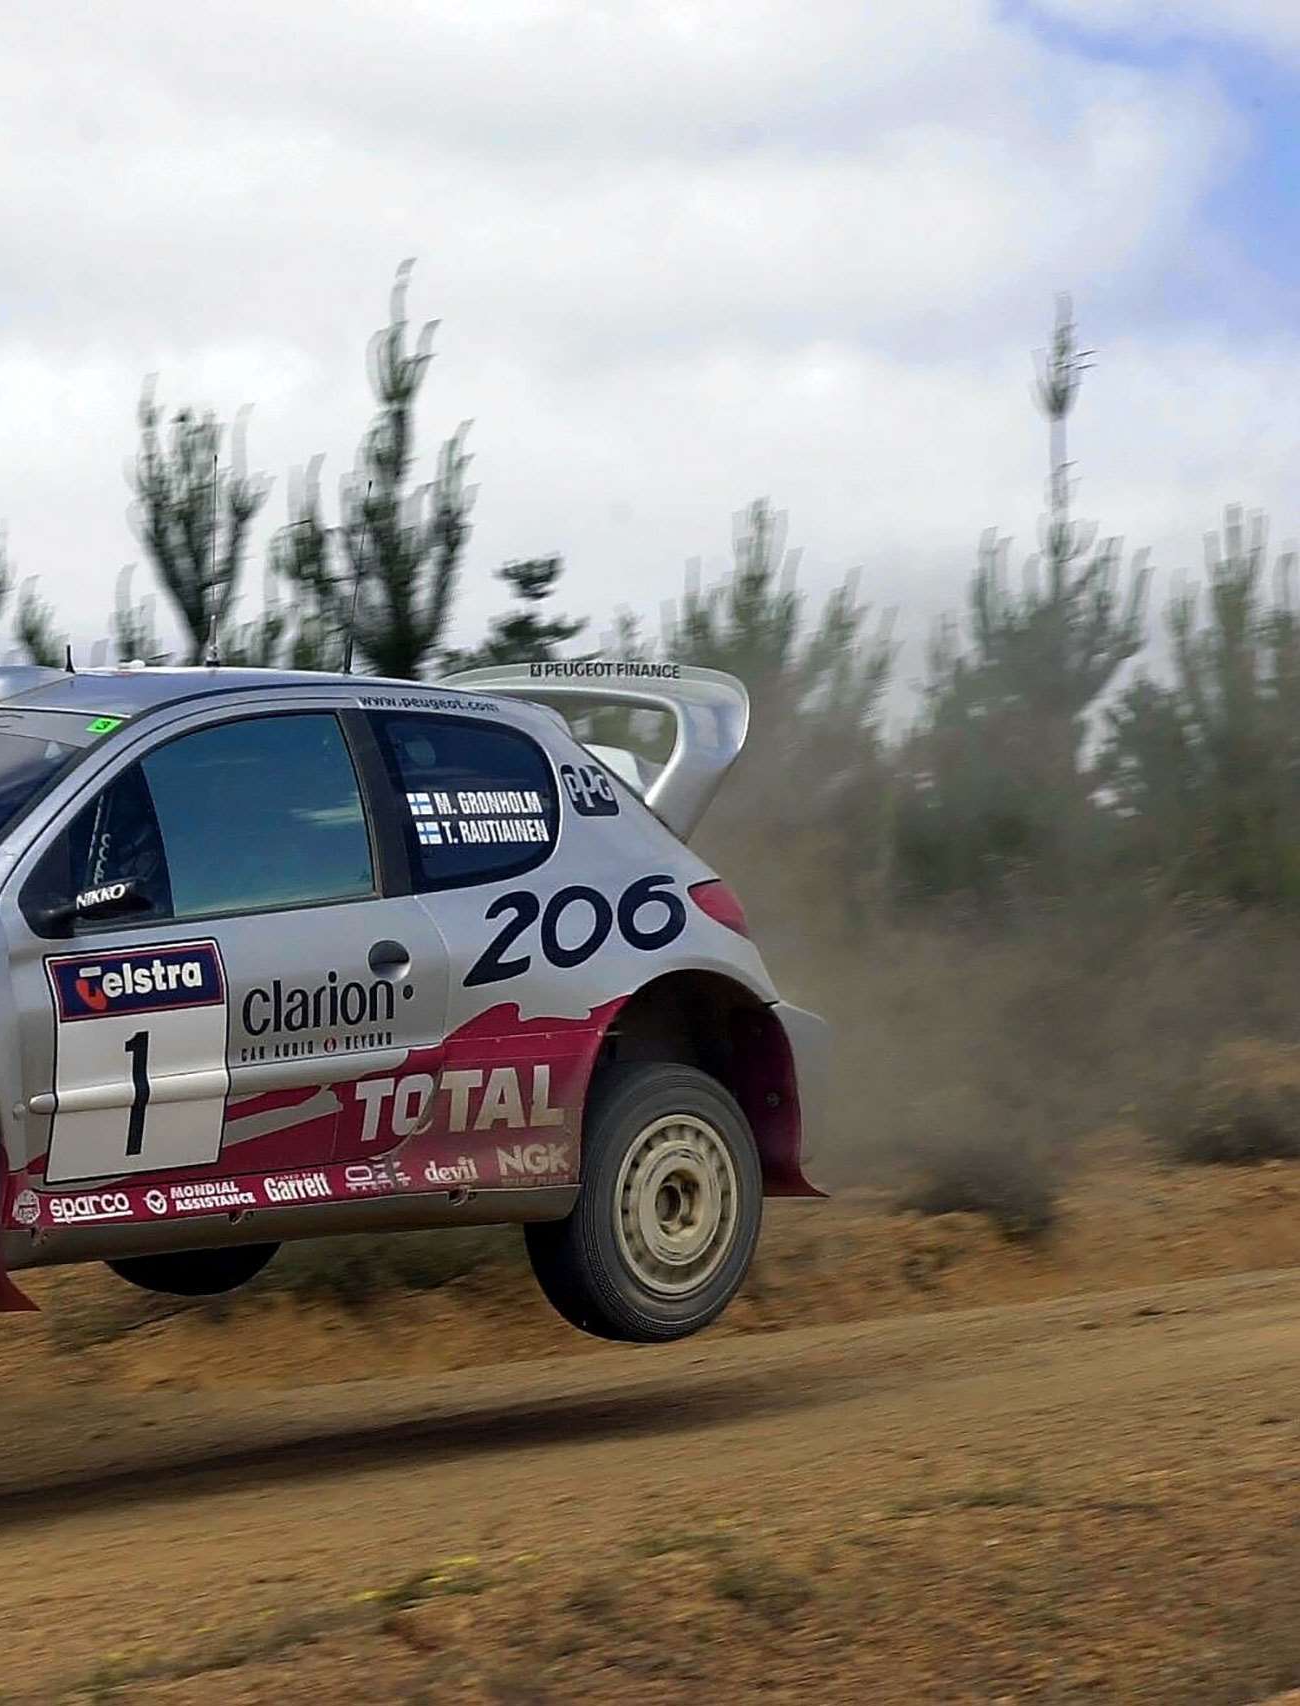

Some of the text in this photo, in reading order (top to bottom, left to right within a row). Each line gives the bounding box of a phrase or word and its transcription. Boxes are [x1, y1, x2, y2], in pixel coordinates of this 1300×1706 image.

[545, 662, 680, 679] PEUGEOT FINANCE
[358, 696, 500, 712] www.peugeot.com
[562, 766, 614, 808] PPG
[433, 791, 543, 815] M. GRONHOLM
[441, 819, 550, 844] T. RAUTIAINEN
[76, 883, 126, 910] NIKKO
[463, 874, 687, 988] 206
[76, 959, 203, 1011] Telstra
[241, 1031, 393, 1062] CAR AUDIO BEYOND
[124, 1030, 150, 1157] 1
[355, 1063, 565, 1143] TOTAL
[423, 1155, 480, 1183] devil
[496, 1143, 571, 1176] NGK
[170, 1180, 239, 1200] MONDIAL
[263, 1172, 332, 1203] Garrett
[50, 1192, 130, 1219] sparco
[175, 1192, 257, 1212] ASSISTANCE
